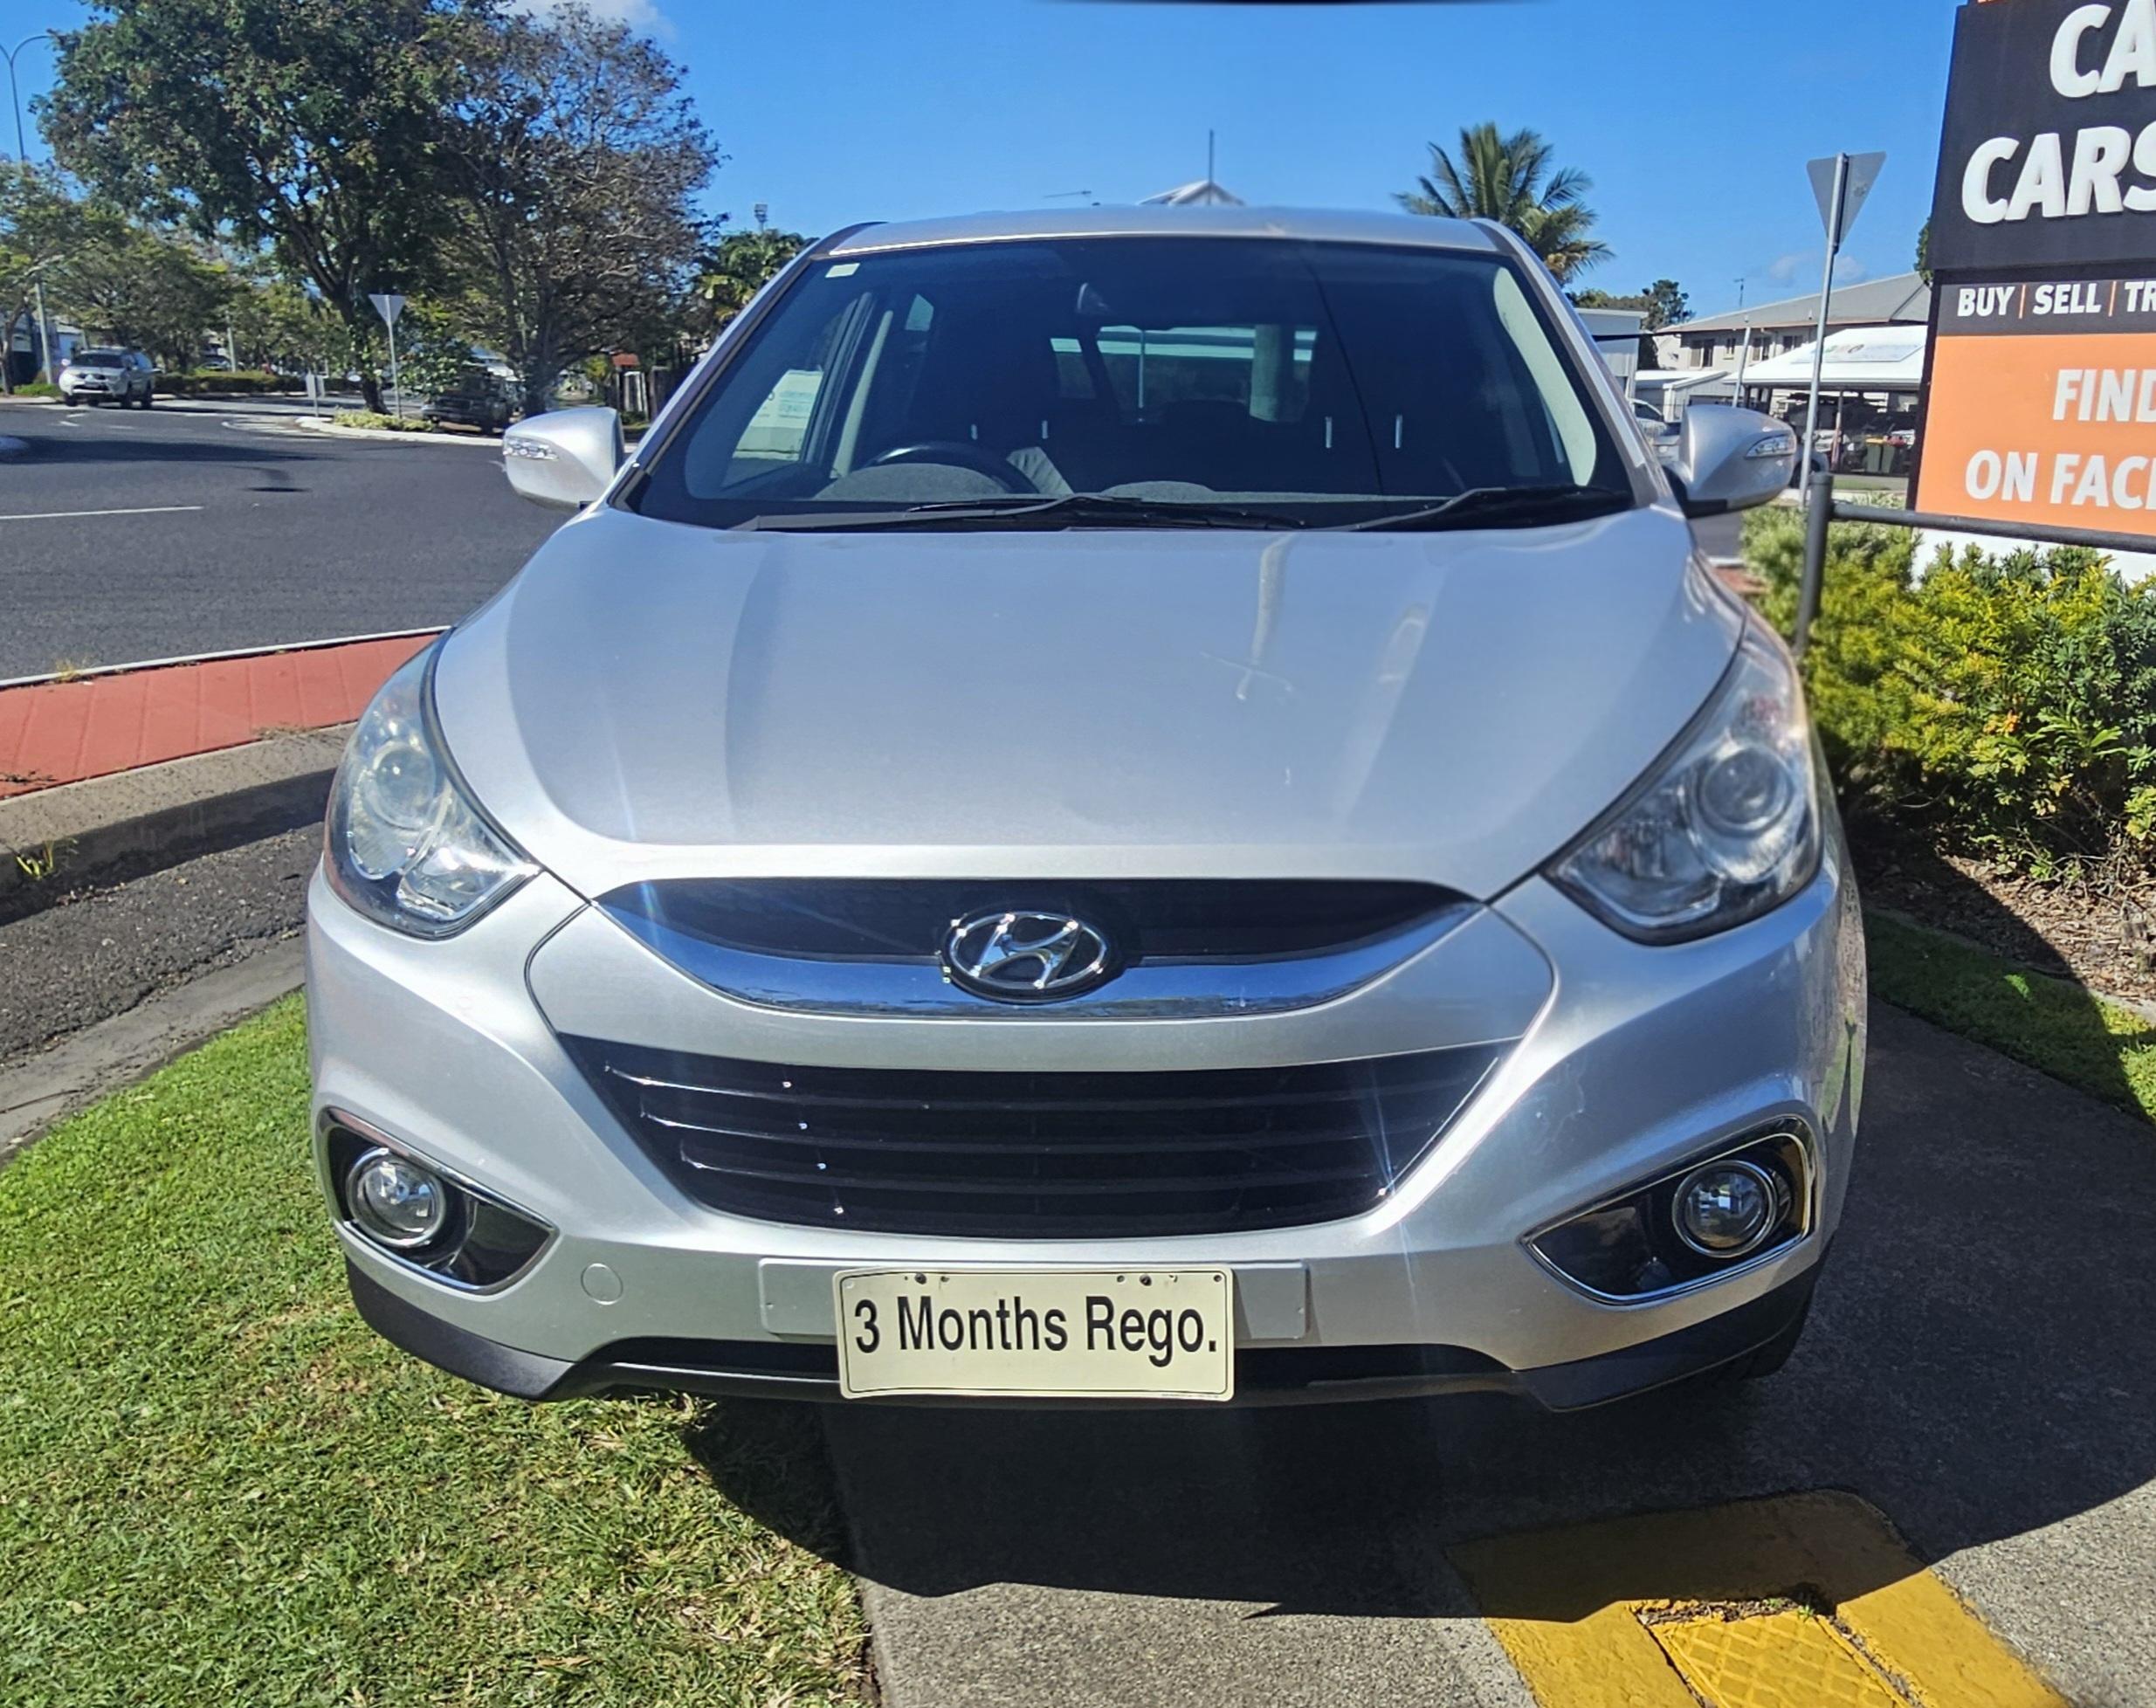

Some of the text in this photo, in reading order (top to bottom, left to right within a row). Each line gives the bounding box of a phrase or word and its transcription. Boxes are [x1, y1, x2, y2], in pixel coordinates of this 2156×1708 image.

[2050, 0, 2156, 98] CA
[1962, 121, 2156, 224] CARS
[1957, 286, 2015, 317] BUY
[2033, 283, 2101, 315] SELL
[1965, 450, 2038, 502] ON
[854, 1295, 1217, 1367] 3 Months Rego.
